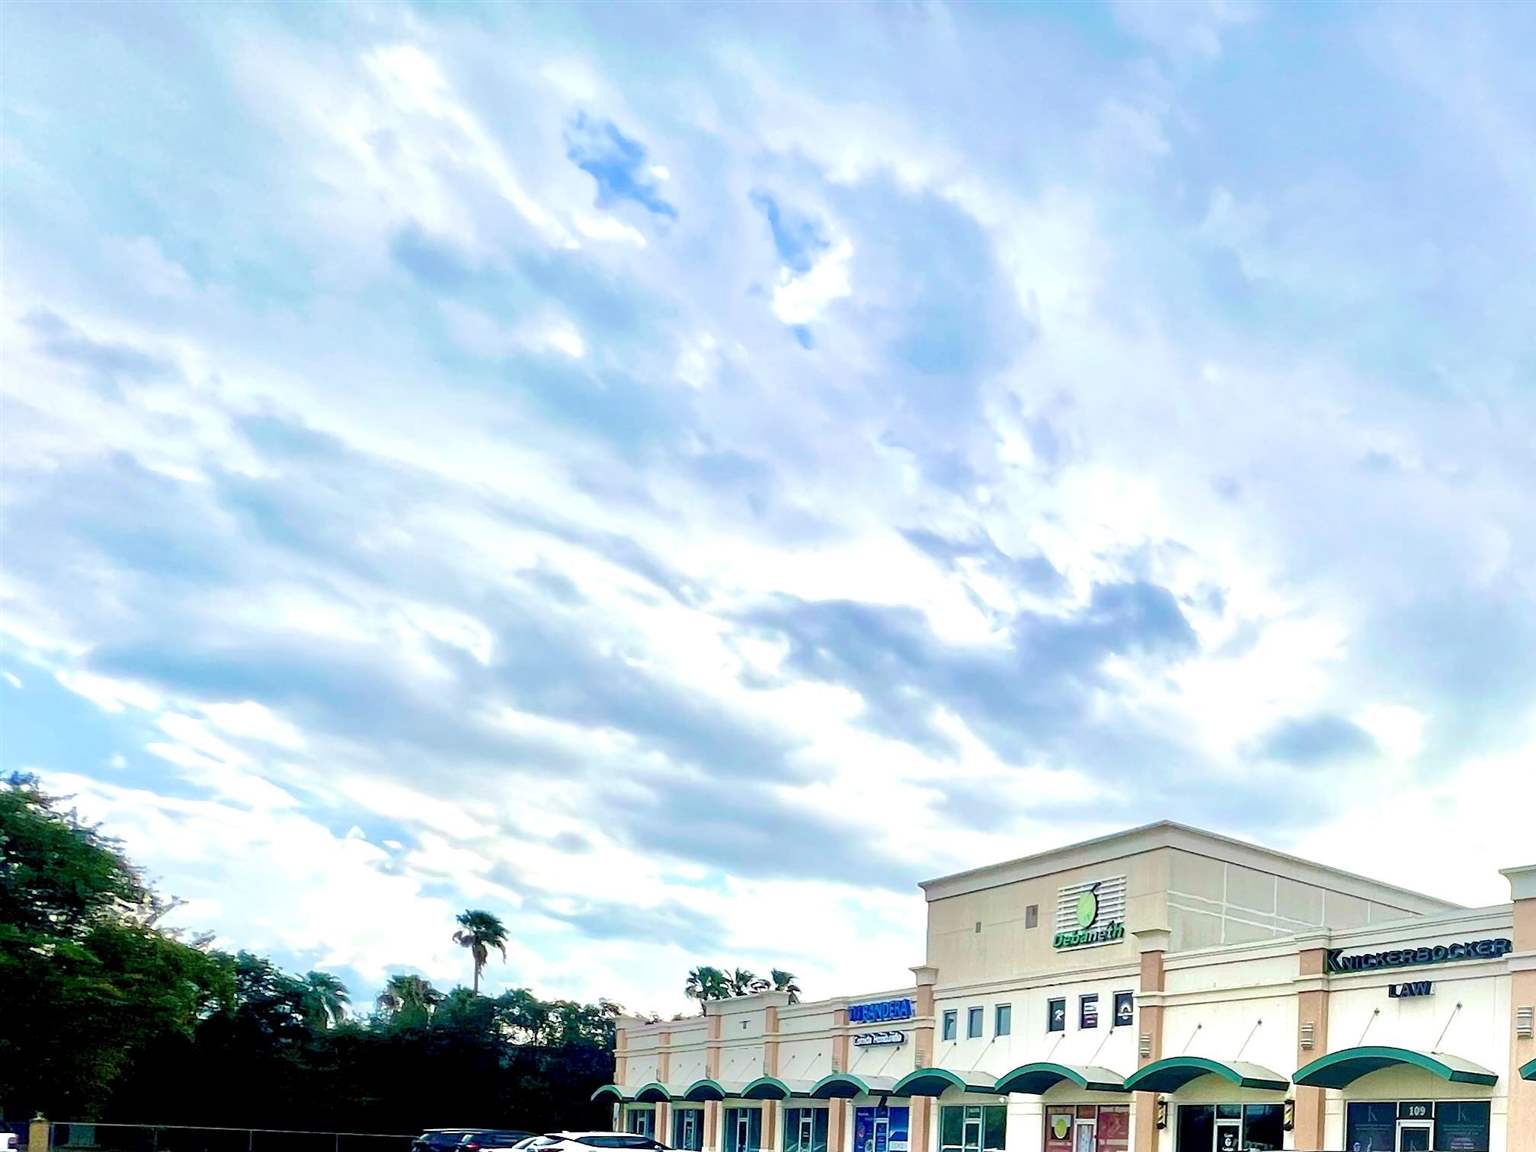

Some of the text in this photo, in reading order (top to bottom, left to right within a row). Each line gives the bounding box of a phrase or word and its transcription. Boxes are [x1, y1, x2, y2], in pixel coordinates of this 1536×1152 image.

[1327, 938, 1512, 975] KNICKERBOCKER
[1388, 981, 1433, 998] LAW
[1409, 1106, 1426, 1116] 109
